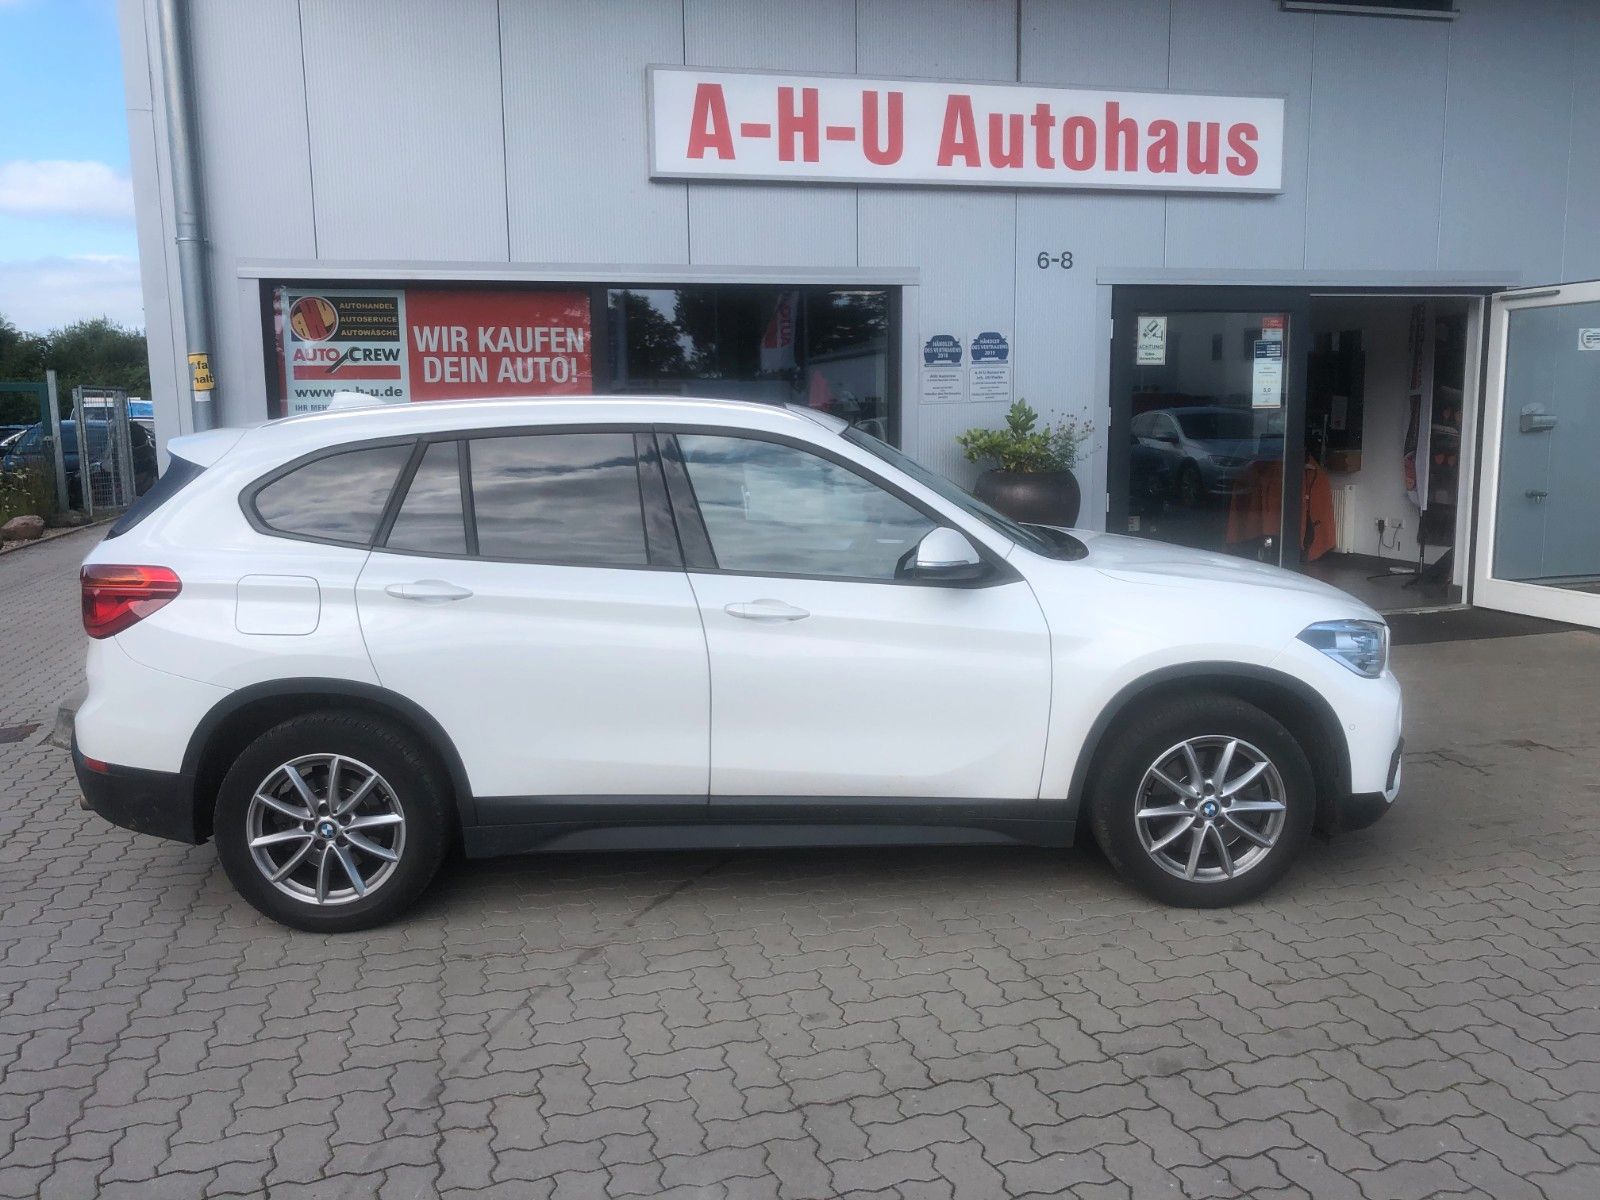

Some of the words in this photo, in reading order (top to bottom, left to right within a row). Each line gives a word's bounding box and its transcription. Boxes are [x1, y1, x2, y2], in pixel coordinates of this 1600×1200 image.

[686, 82, 904, 166] A-H-U
[936, 93, 1259, 177] Autohaus
[1037, 251, 1073, 270] 6-8
[339, 302, 395, 310] AUTOHANDEL
[413, 325, 469, 353] WIR
[477, 326, 585, 353] KAUFEN
[423, 356, 489, 384] DEIN
[497, 357, 579, 384] AUTO!
